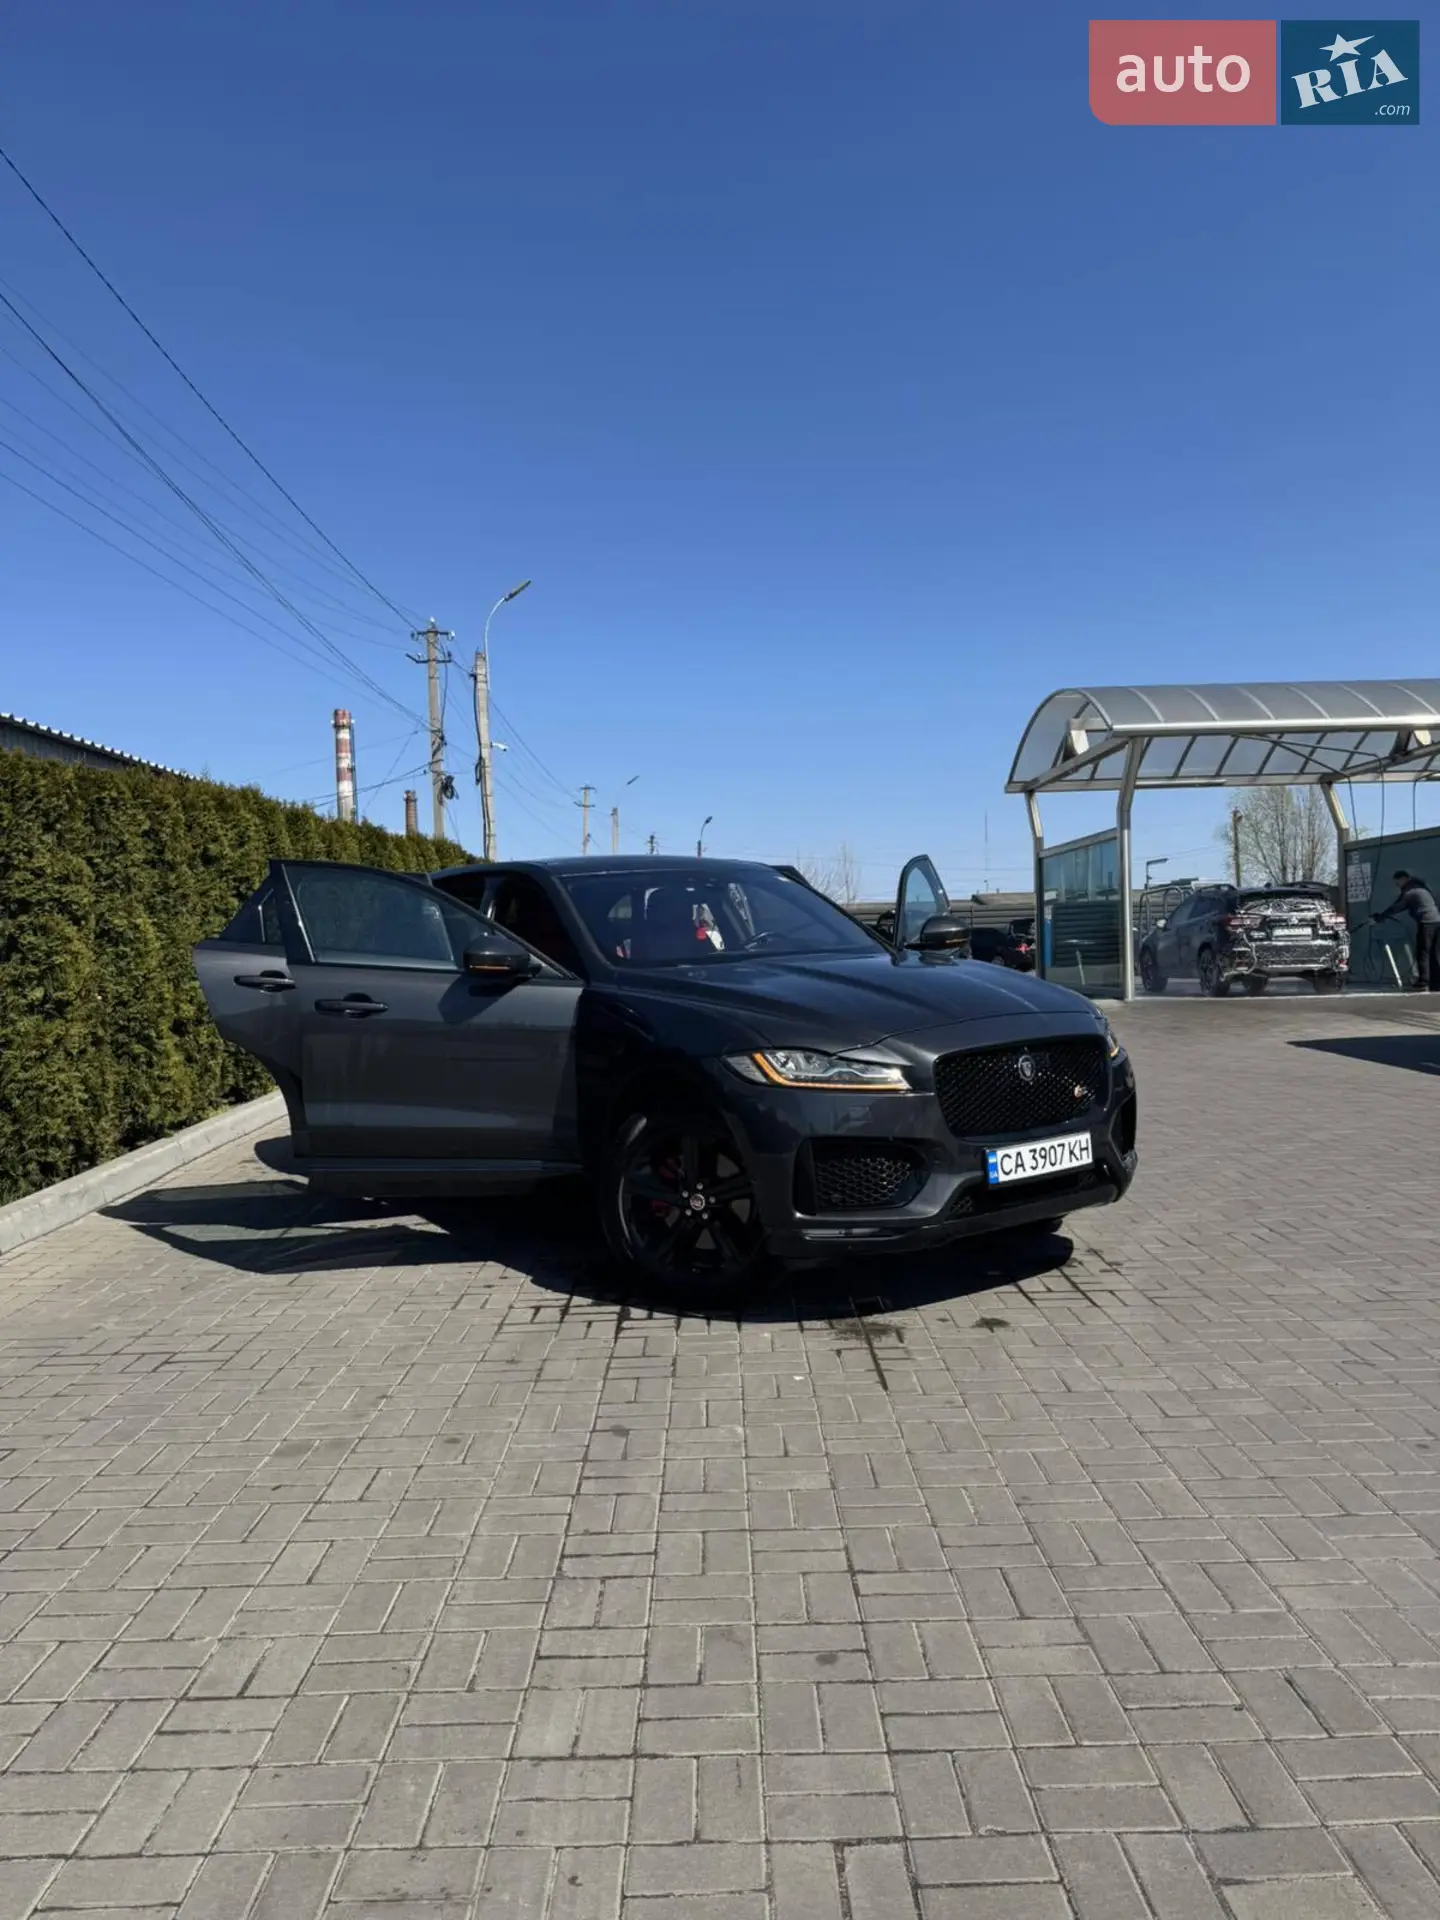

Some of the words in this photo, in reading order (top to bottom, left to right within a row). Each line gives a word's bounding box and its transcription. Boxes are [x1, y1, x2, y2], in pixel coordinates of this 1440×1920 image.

[1000, 1152, 1026, 1176] CA
[1029, 1143, 1066, 1170] 3907
[1068, 1138, 1090, 1163] KH
